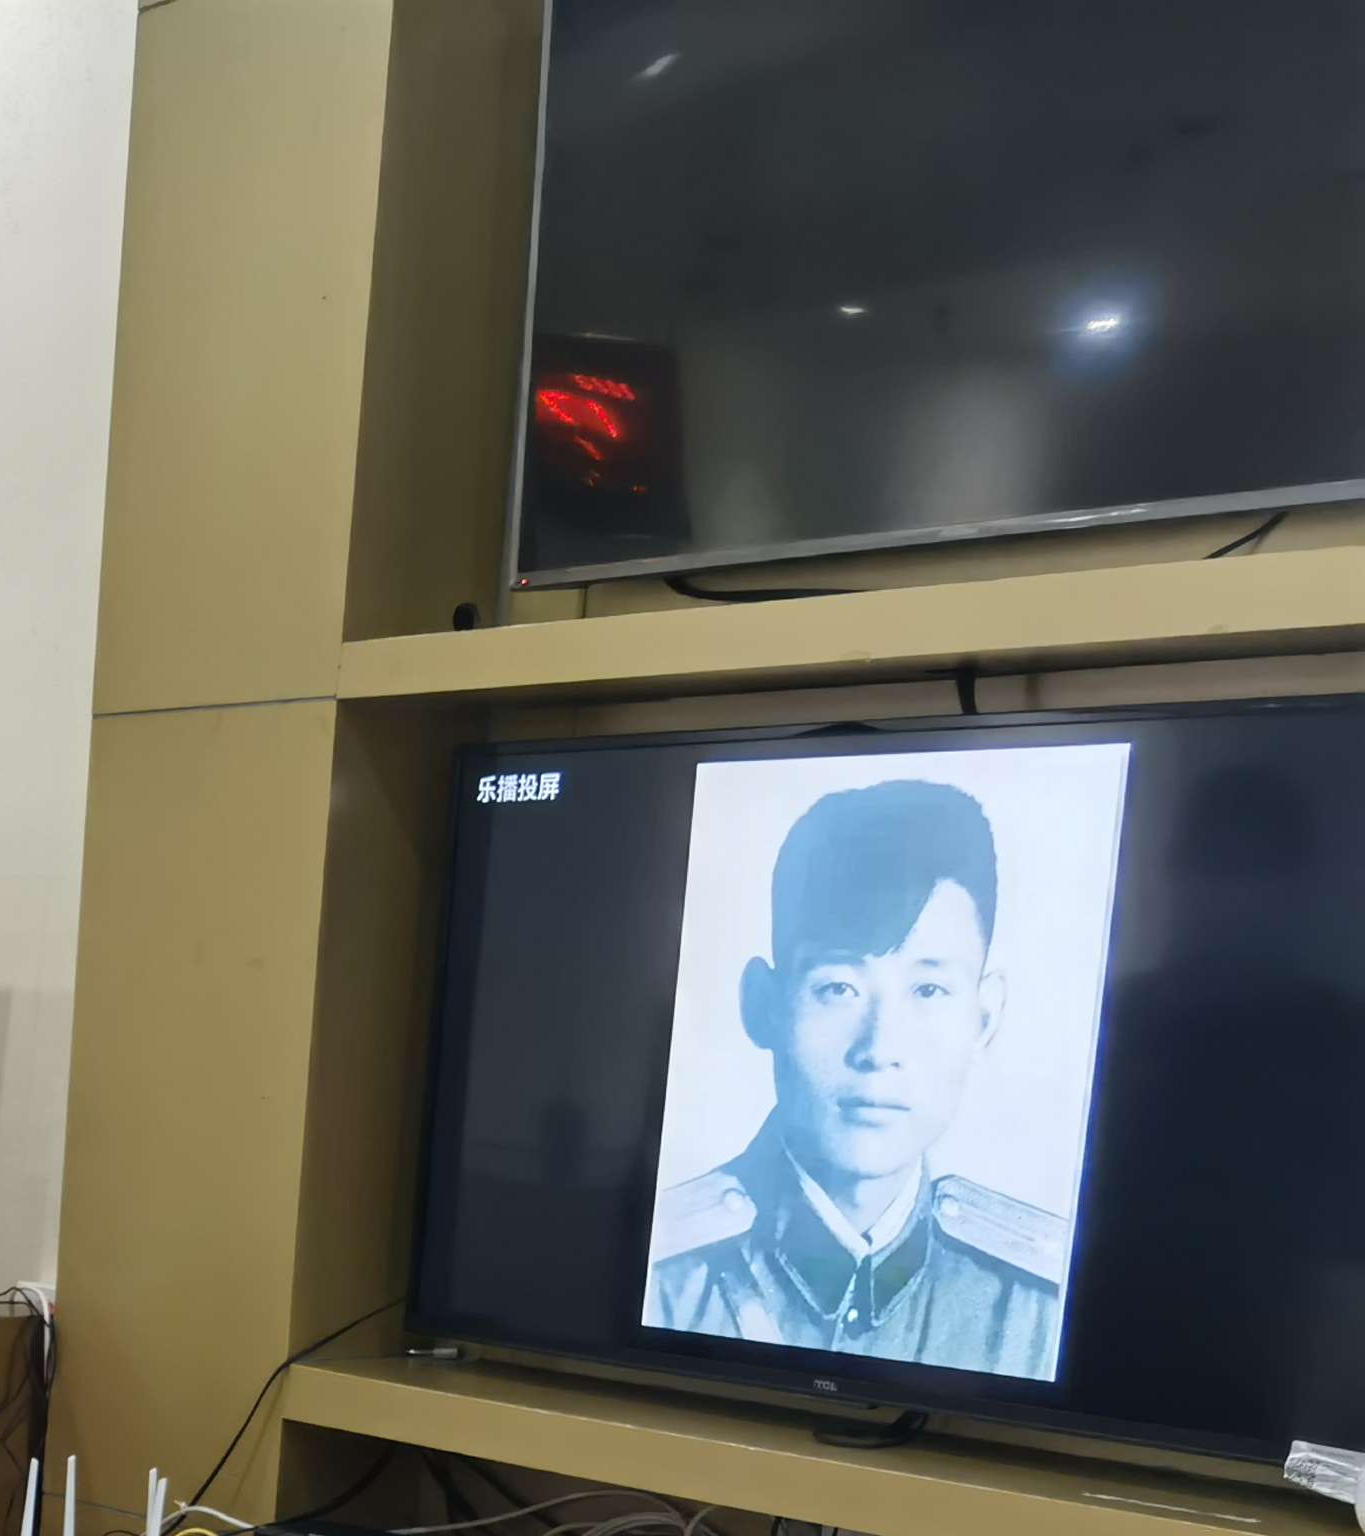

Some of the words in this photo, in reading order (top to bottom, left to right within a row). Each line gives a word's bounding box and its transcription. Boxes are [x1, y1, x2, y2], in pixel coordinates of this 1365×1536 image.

[476, 772, 562, 804] 乐播投屏
[813, 1379, 838, 1392] TCL
